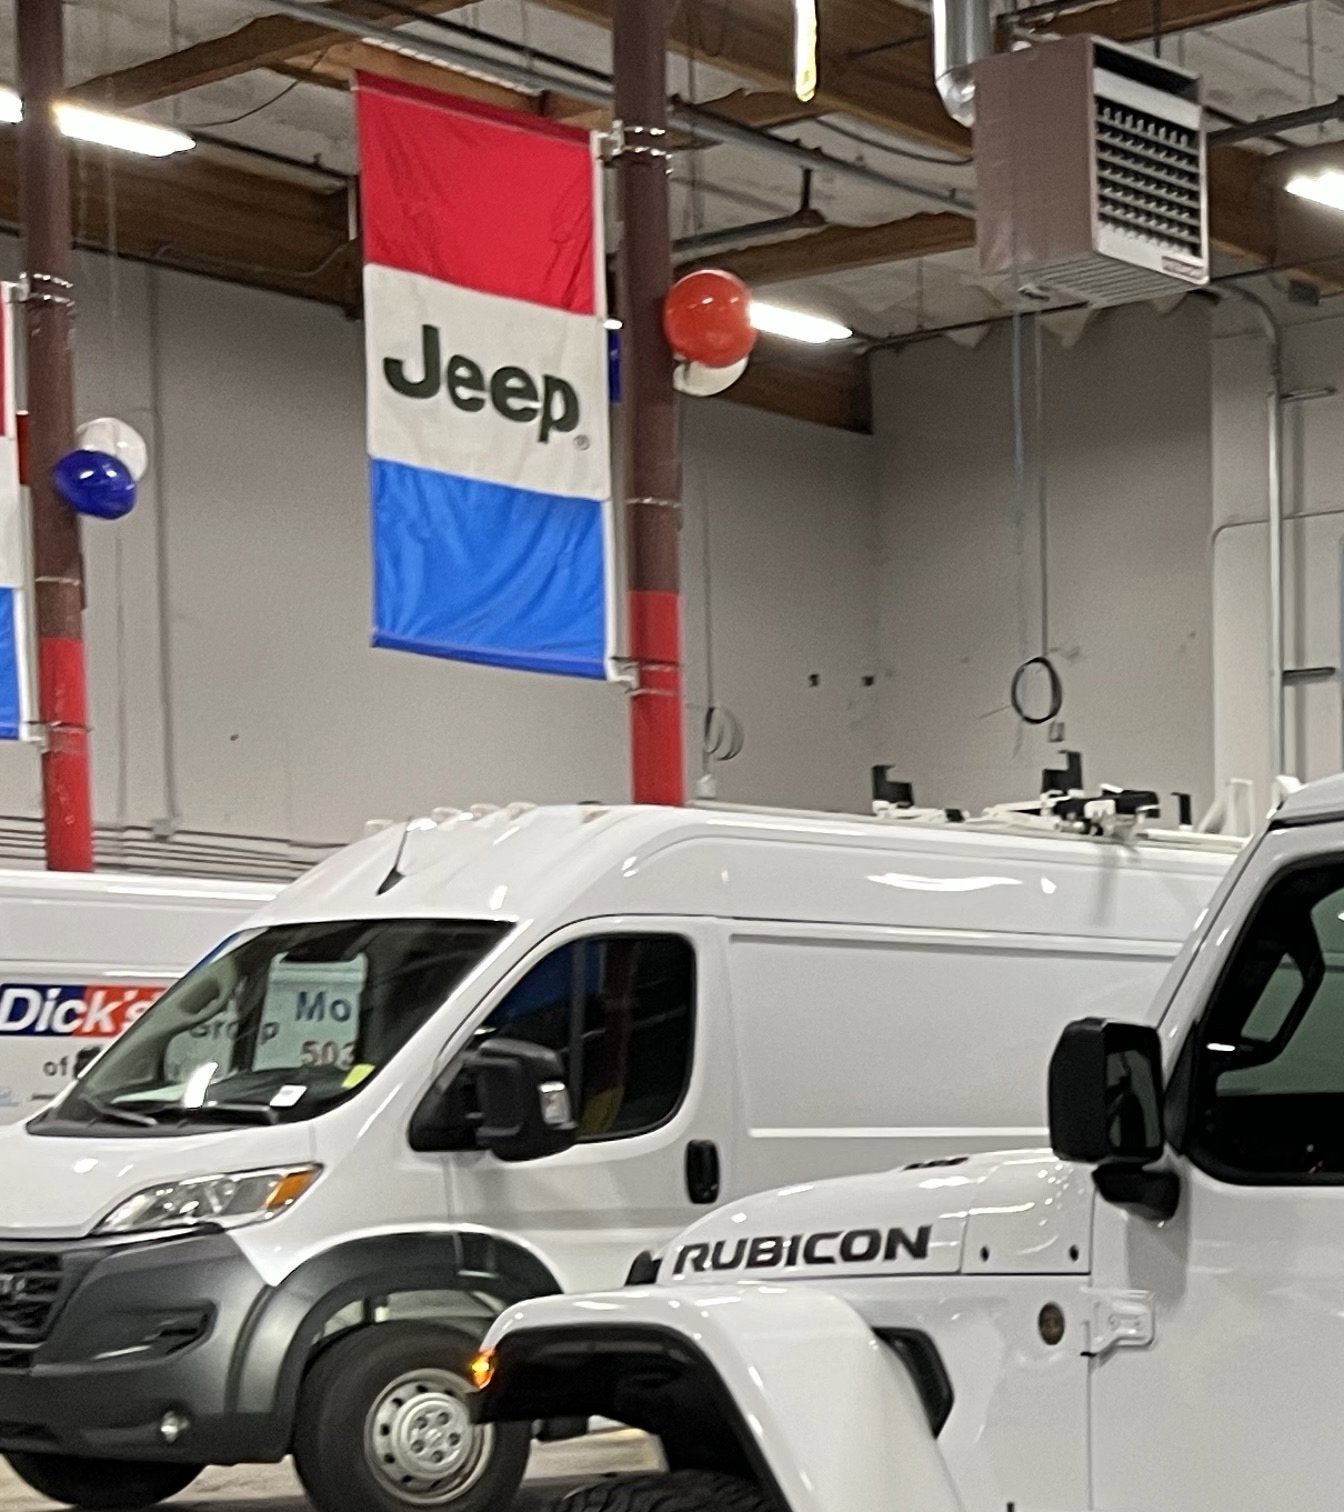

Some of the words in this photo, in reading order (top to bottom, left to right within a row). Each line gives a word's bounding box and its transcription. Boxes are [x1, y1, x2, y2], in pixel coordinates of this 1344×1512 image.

[383, 323, 580, 444] Jeep
[43, 1056, 70, 1077] of
[672, 1224, 933, 1276] RUBICON
